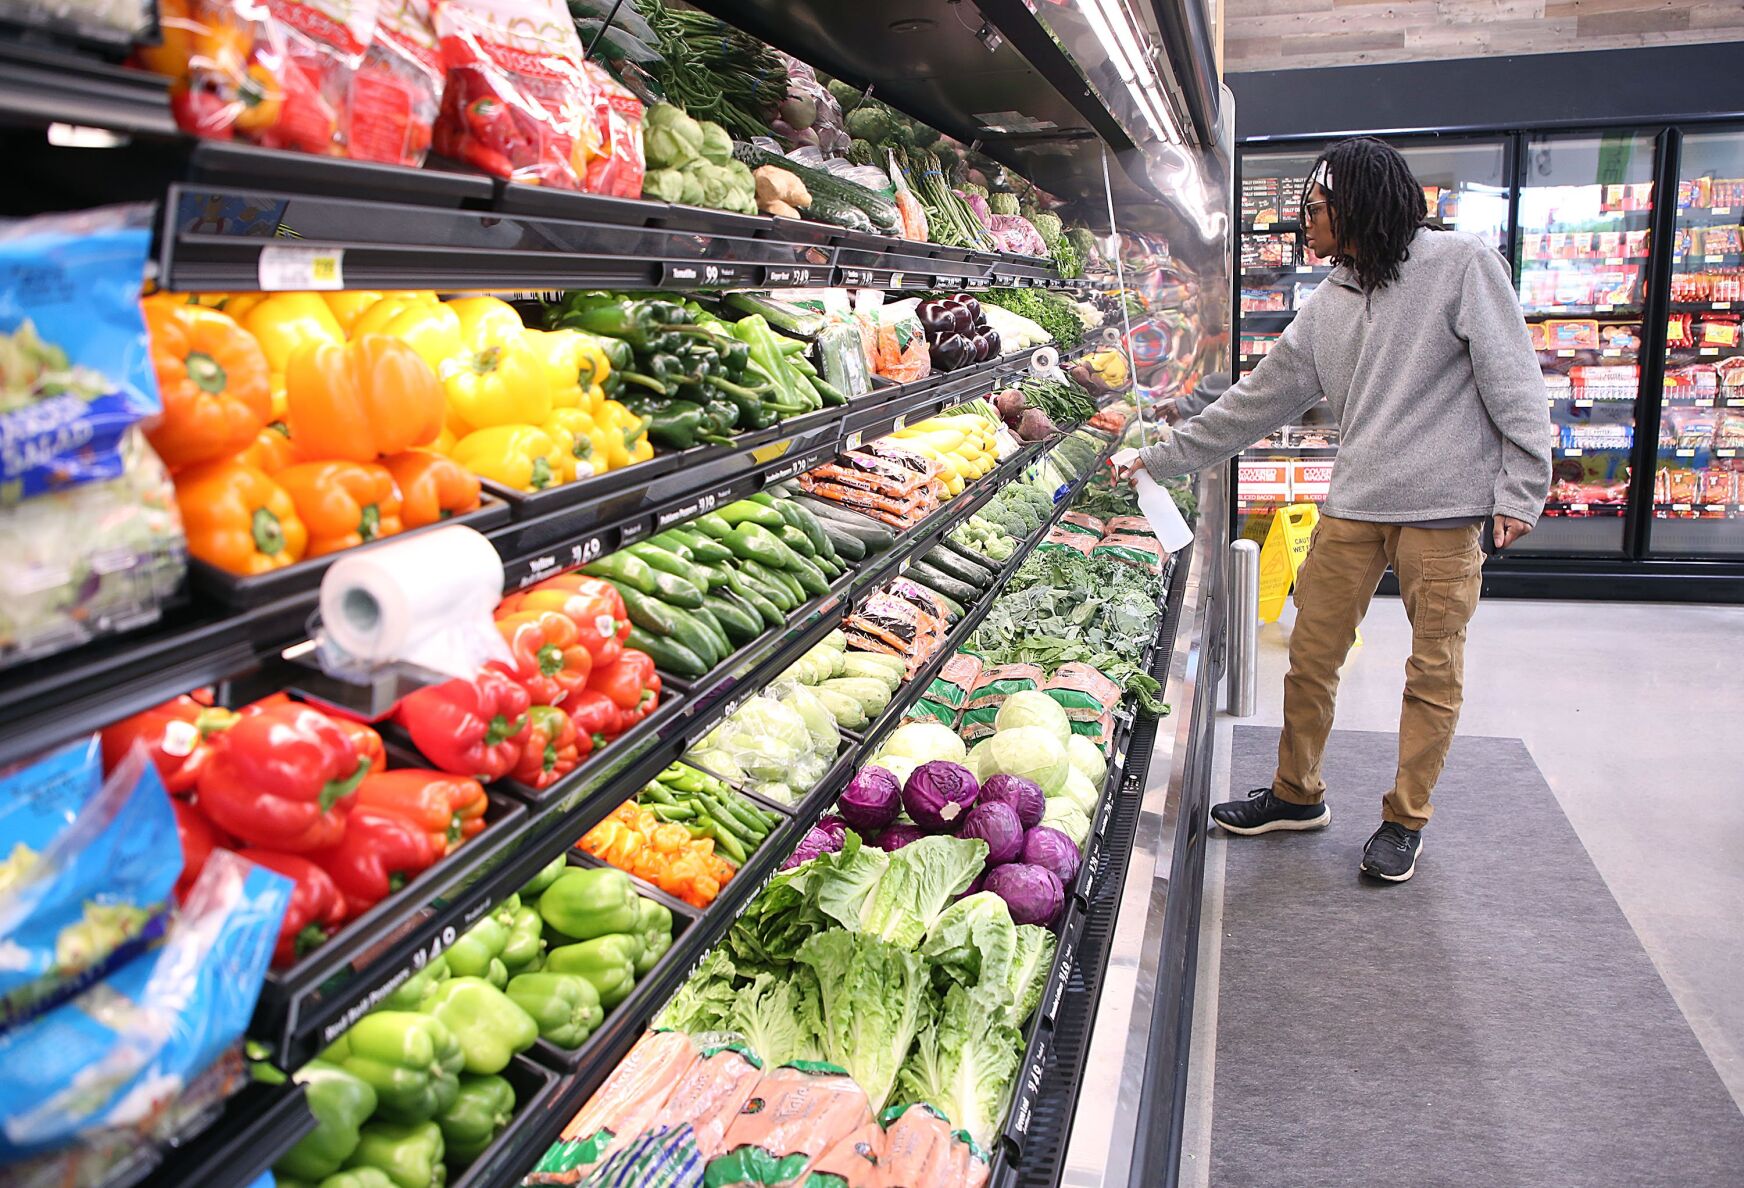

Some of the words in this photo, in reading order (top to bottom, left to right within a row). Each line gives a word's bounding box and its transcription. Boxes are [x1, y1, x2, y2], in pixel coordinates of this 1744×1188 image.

[1239, 468, 1277, 476] COVERED
[1304, 468, 1332, 476] COVER
[857, 481, 870, 489] Facts
[1295, 537, 1310, 545] CAUT
